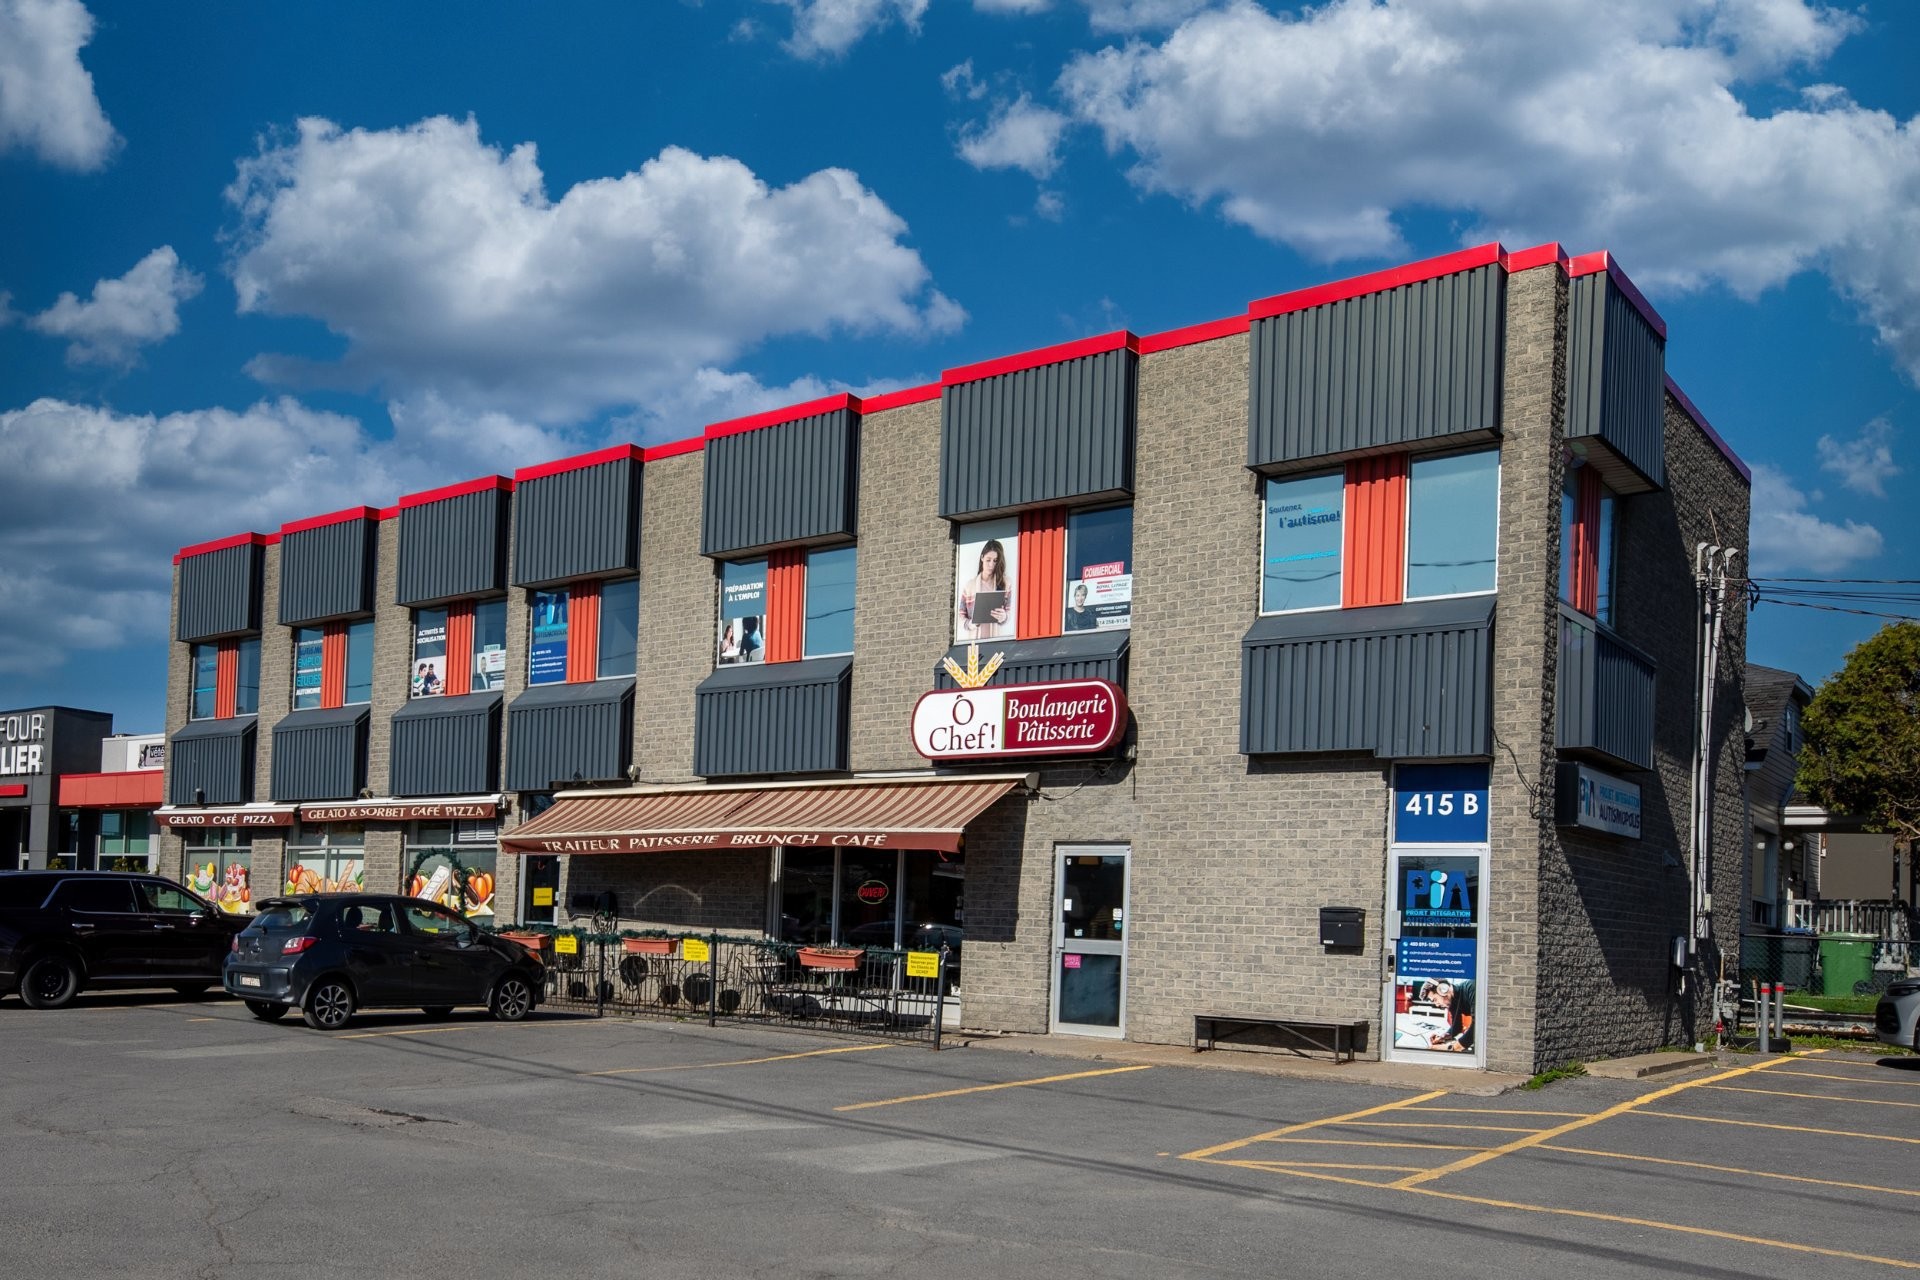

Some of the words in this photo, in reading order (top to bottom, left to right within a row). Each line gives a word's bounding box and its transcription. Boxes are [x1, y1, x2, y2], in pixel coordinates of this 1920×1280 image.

[1268, 504, 1302, 514] Soutenez
[1279, 510, 1341, 528] l'autisme!
[1084, 564, 1122, 578] COMMERCIAL
[725, 582, 764, 593] PRÉPARATION
[728, 593, 734, 601] À
[734, 591, 760, 600] L'EMPLOI
[952, 694, 975, 725] Ô
[1007, 693, 1107, 720] Boulangerie
[929, 722, 996, 752] Chef!
[1017, 719, 1095, 742] Pâtisserie
[309, 808, 347, 819] GELATO
[349, 808, 357, 817] &
[360, 807, 406, 817] SORBET
[411, 804, 440, 816] CAFÉ
[445, 806, 484, 816] PIZZA
[1405, 793, 1454, 816] 415
[1463, 793, 1479, 815] B
[169, 815, 205, 824] GELATO
[212, 813, 237, 824] CAFÉ
[243, 815, 275, 824] PIZZA
[1599, 803, 1640, 829] AUTISMOPOLIS
[542, 838, 620, 851] TRAITEUR
[629, 835, 720, 849] PATISSERIE
[731, 834, 819, 845] BRUNCH
[831, 833, 888, 846] CAFÉ
[1430, 910, 1471, 918] INTEGRATION
